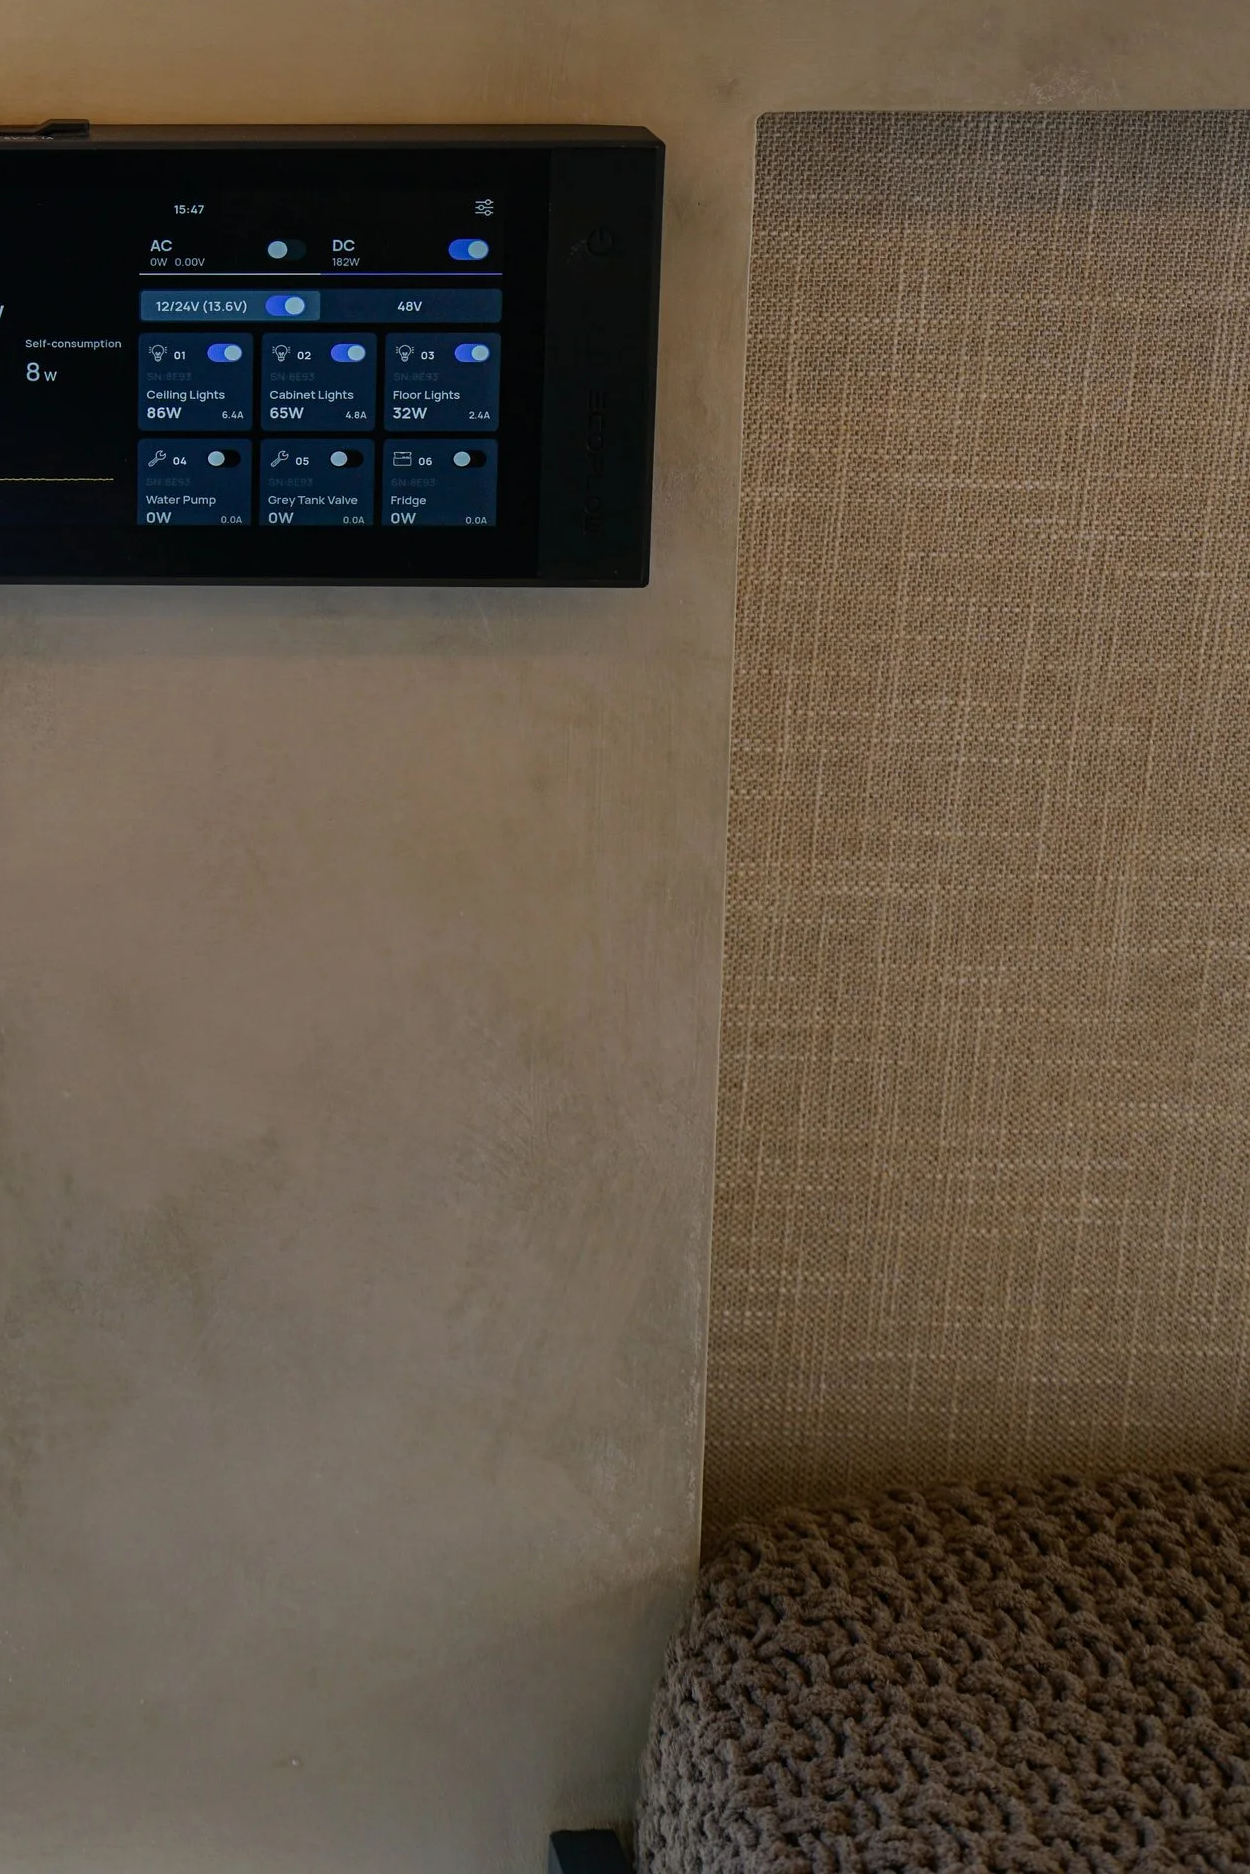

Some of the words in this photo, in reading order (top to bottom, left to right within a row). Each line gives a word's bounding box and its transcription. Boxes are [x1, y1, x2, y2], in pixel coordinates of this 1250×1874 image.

[174, 205, 204, 214] 15:47
[150, 240, 172, 251] AC
[333, 240, 355, 251] DC
[150, 258, 167, 266] 0W
[175, 258, 205, 266] 0.00V
[332, 258, 360, 266] 182W
[156, 302, 199, 311] 12/24V
[203, 300, 247, 313] (13.6V)
[398, 301, 422, 311] 48V
[26, 340, 121, 350] Self-consumption
[174, 351, 185, 359] 01
[297, 351, 311, 359] 02
[421, 351, 434, 359] 03
[27, 362, 39, 381] 8
[147, 390, 187, 402] Ceiling
[190, 390, 225, 402] Lights
[270, 391, 315, 399] Cabinet
[318, 391, 353, 402] Lights
[393, 391, 422, 399] Floor
[425, 391, 460, 402] Lights
[147, 407, 181, 418] 86W
[222, 411, 243, 419] 6.4A
[270, 407, 304, 419] 65W
[346, 411, 366, 419] 4.8A
[393, 407, 427, 419] 32W
[469, 411, 490, 419] 2.4A
[173, 457, 186, 465] 04
[296, 457, 309, 465] 05
[419, 457, 432, 465] 06
[146, 496, 180, 504] Water
[183, 496, 216, 507] Pump
[268, 496, 296, 507] Grey
[297, 496, 325, 504] Tank
[327, 496, 358, 504] Valve
[391, 496, 426, 507] Fridge
[147, 512, 171, 523] 0W
[269, 512, 294, 523] 0W
[343, 516, 364, 524] 0.0A
[391, 513, 416, 524] 0W
